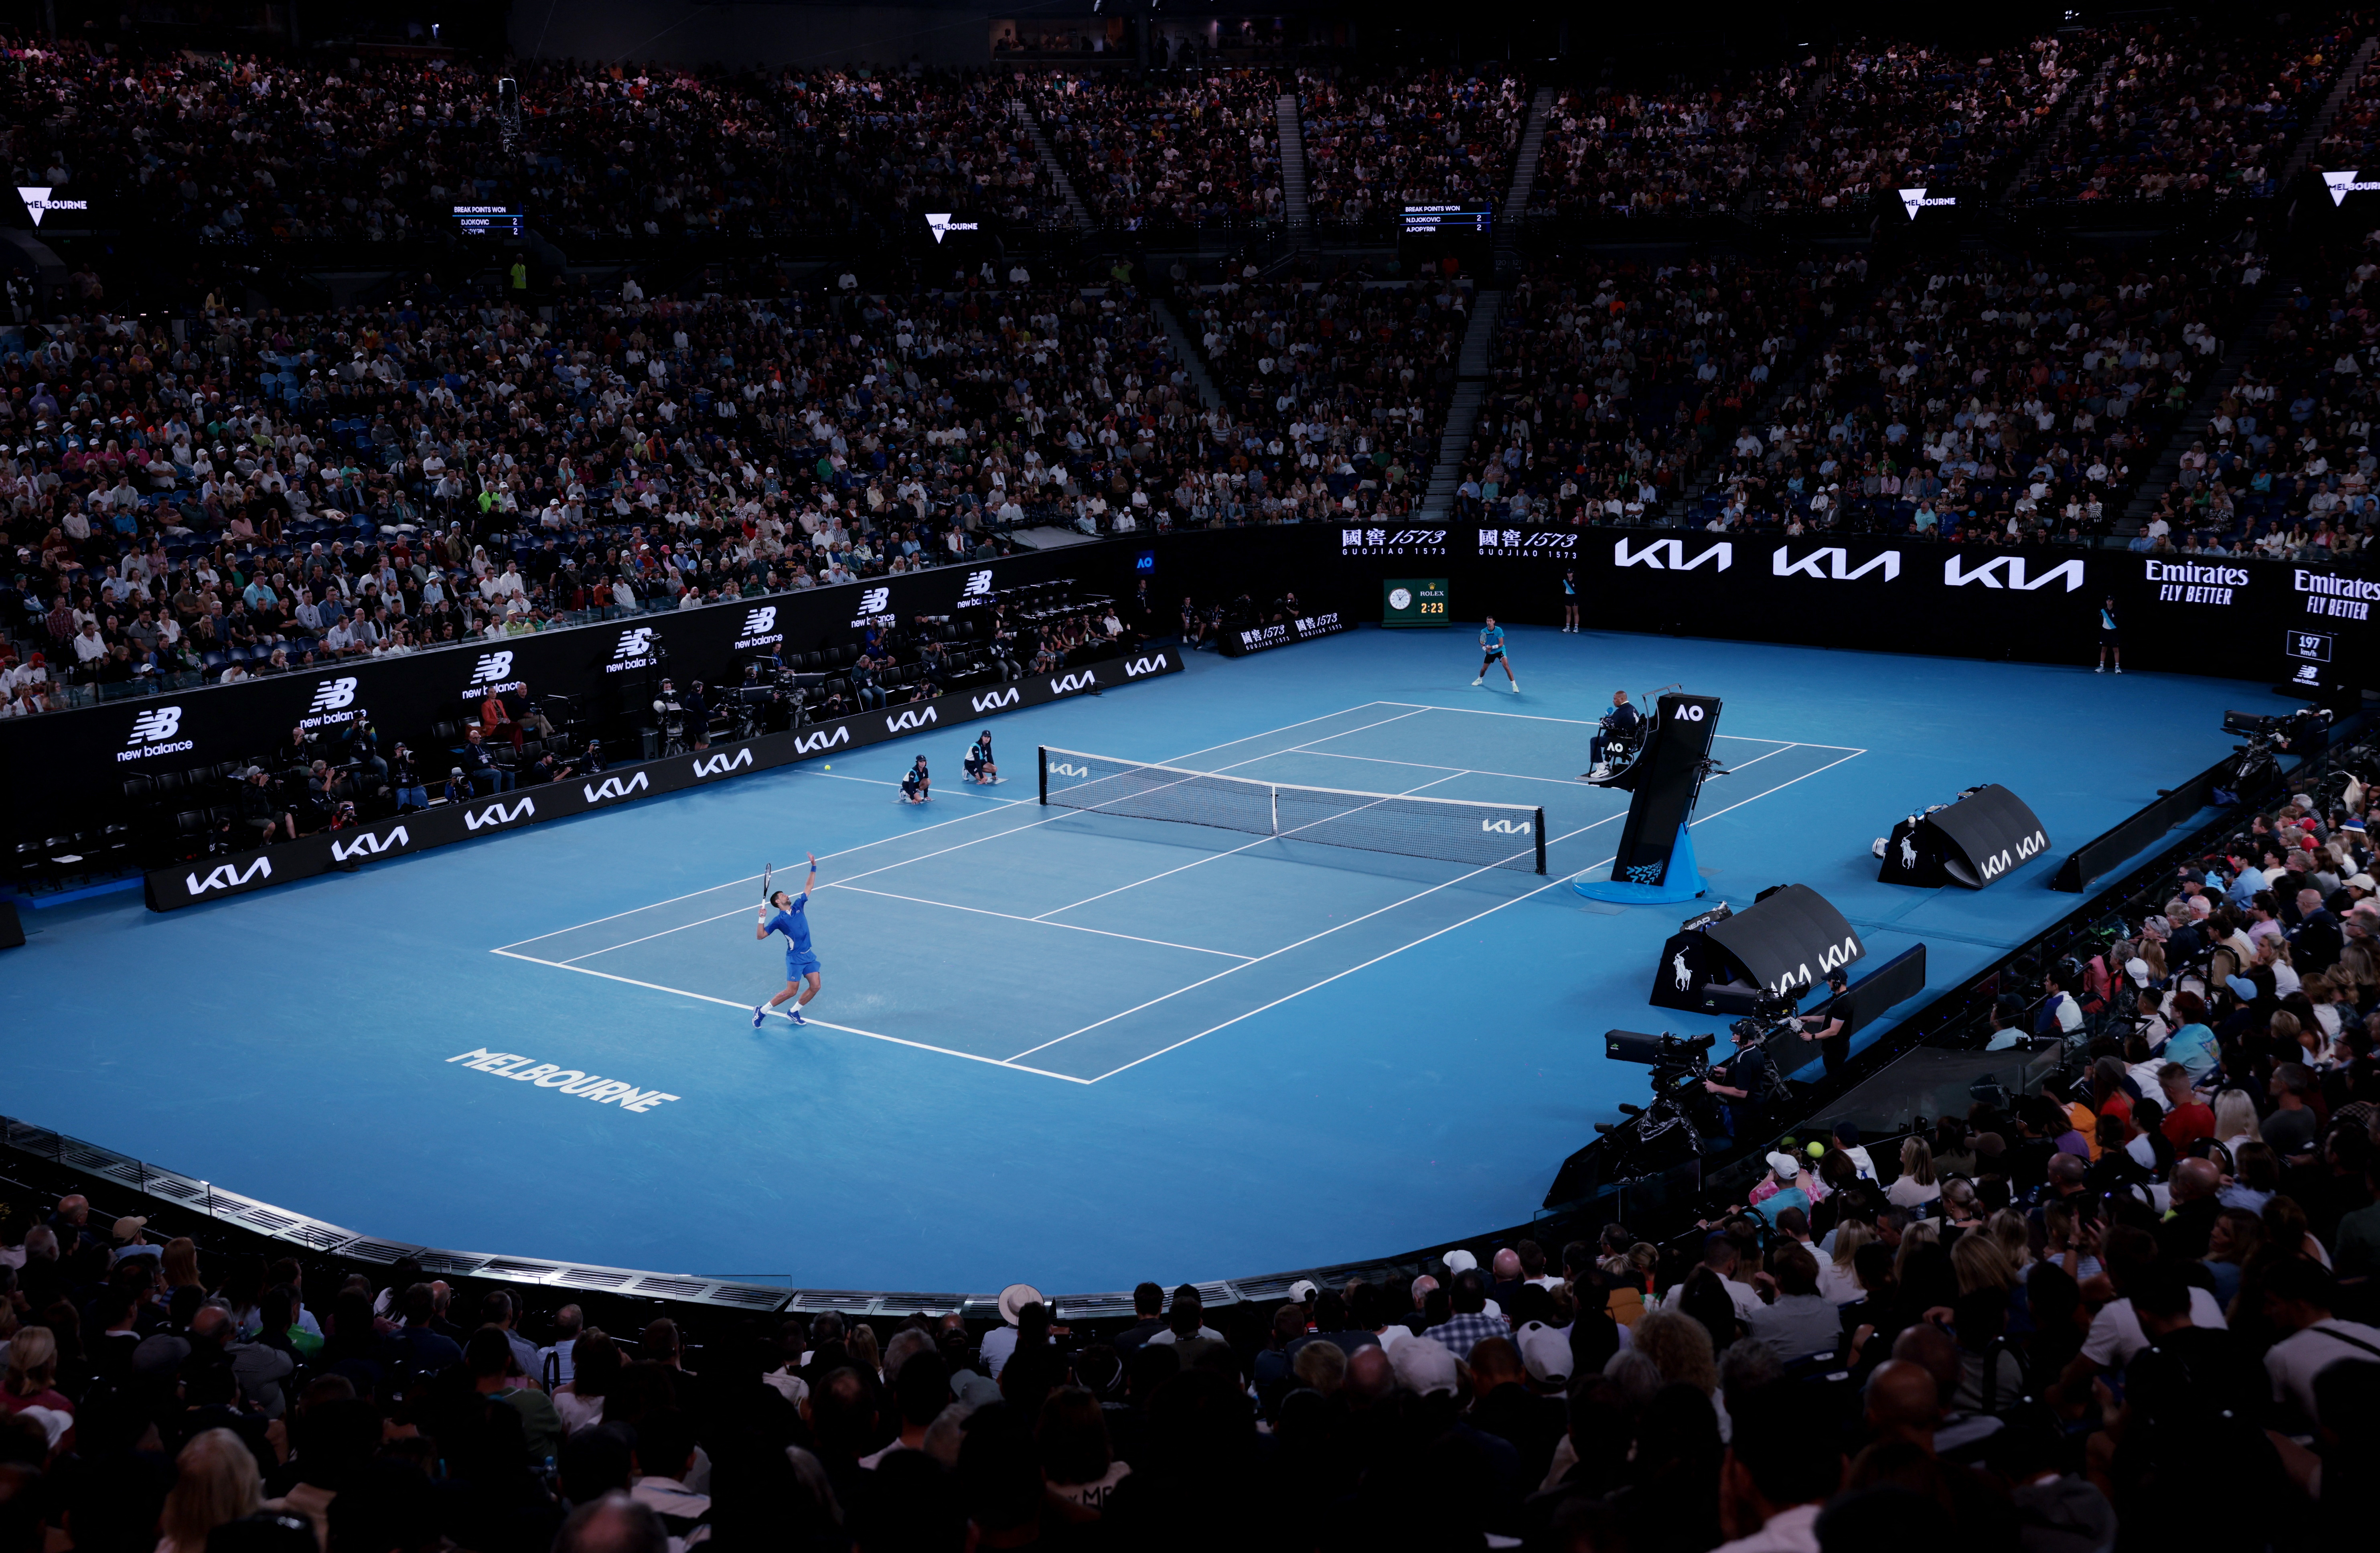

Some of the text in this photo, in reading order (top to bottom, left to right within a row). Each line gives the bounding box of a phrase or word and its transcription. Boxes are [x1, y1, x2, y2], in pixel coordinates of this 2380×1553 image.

[2328, 182, 2380, 191] MELBOUR
[25, 200, 87, 209] MELBOURNE
[1904, 197, 1956, 206] MELBOURNE
[513, 217, 518, 225] 2
[931, 223, 978, 231] MELBOURNE
[199, 235, 203, 245] 2
[559, 227, 563, 236] 3
[1137, 557, 1153, 568] AO
[1479, 548, 1577, 559] GUOJIAO 1573
[1615, 537, 1732, 572] KIA
[1773, 545, 1900, 582] KIA
[1944, 554, 2084, 593] KIA
[2146, 560, 2249, 587] Emirates
[2294, 569, 2380, 601] Emirates
[957, 600, 971, 609] new
[2159, 585, 2233, 605] FLY BETTER
[1421, 602, 1443, 614] 2:23
[2306, 595, 2369, 621] FLY BETTER
[851, 613, 895, 628] new bance
[735, 633, 783, 650] new balance
[1300, 627, 1326, 638] GUOJIAO
[2299, 635, 2320, 649] 197
[1246, 635, 1290, 650] GUOJIAO 1573
[2300, 648, 2317, 657] km/h
[606, 662, 624, 673] new
[1125, 654, 1167, 676] KIA
[462, 681, 521, 699] new blanc
[1050, 670, 1095, 694] KIA
[972, 687, 1020, 713] KIA
[300, 709, 367, 729] new balane
[886, 706, 937, 733] KIA
[1674, 704, 1704, 721] AO
[794, 726, 849, 754] KIA
[1606, 742, 1623, 753] AO
[117, 739, 193, 762] new balance
[693, 748, 753, 778] KIA
[1049, 761, 1088, 778] KIA
[584, 771, 649, 803] KIA
[464, 797, 535, 830] KIA
[1482, 818, 1531, 835] KIA
[331, 825, 409, 862] KIA
[2016, 830, 2045, 860] KIA
[1981, 849, 2011, 879] KIA
[186, 856, 272, 895] KIA
[1818, 936, 1857, 973] KIA
[445, 1047, 681, 1113] MELBOURNE
